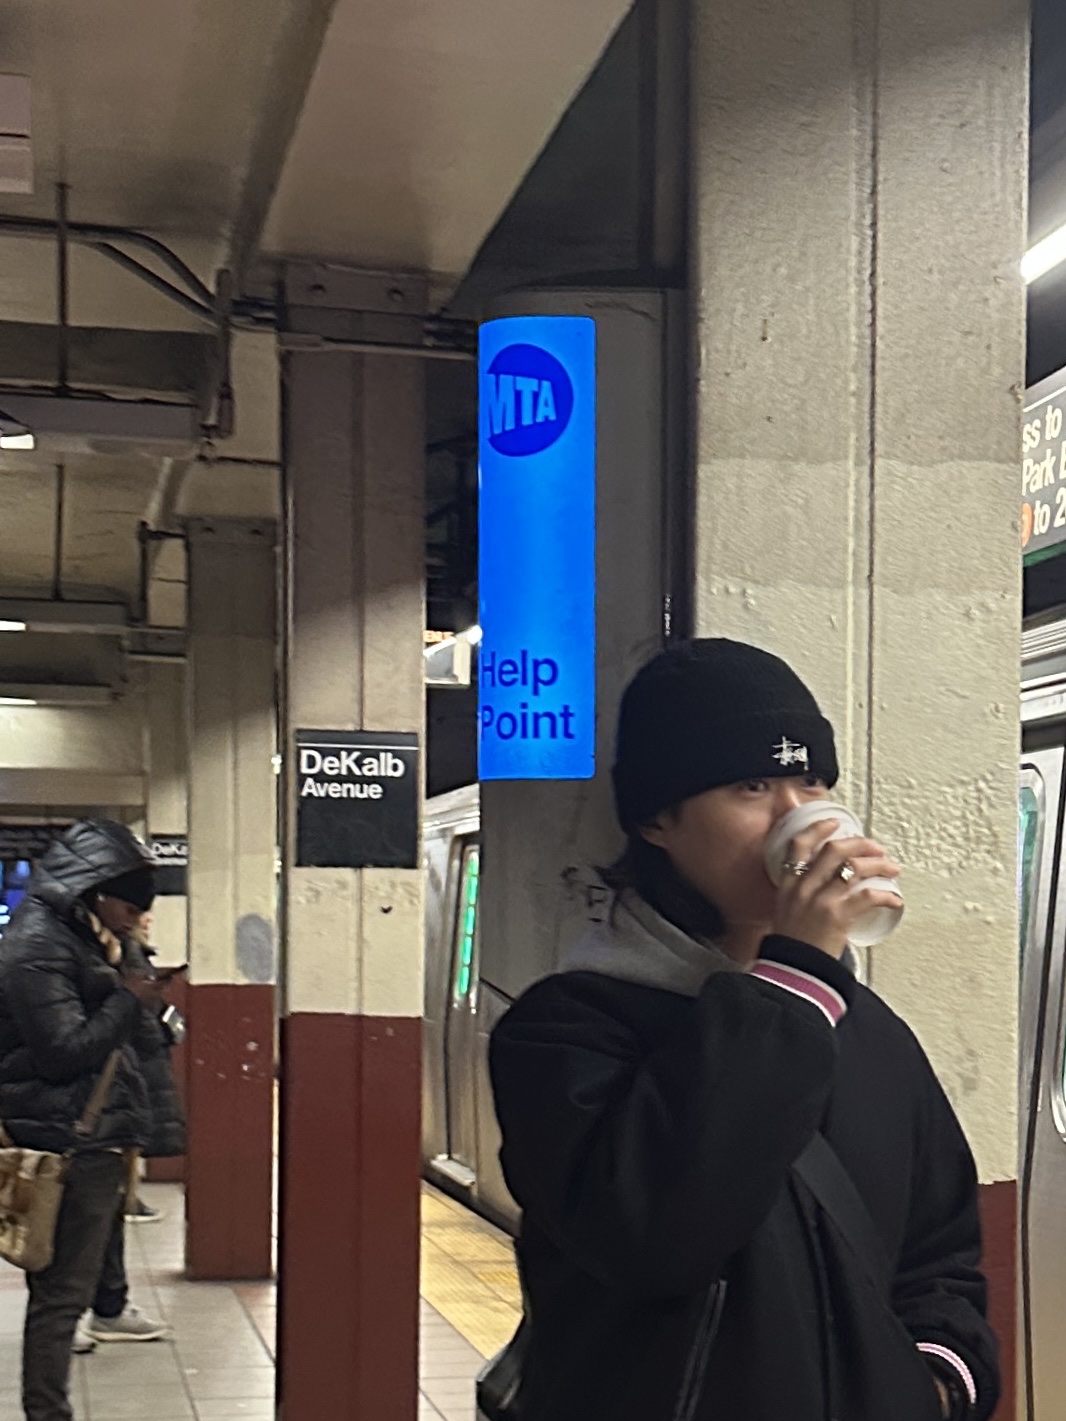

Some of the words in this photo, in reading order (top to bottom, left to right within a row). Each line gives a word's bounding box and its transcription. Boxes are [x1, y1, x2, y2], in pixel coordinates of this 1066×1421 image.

[485, 372, 557, 439] MTA
[1045, 405, 1062, 440] to
[1022, 449, 1056, 496] Park
[1034, 501, 1050, 535] to
[481, 650, 559, 696] Help
[480, 702, 576, 740] Point
[300, 749, 405, 778] DeKalb
[301, 777, 383, 799] Avenue
